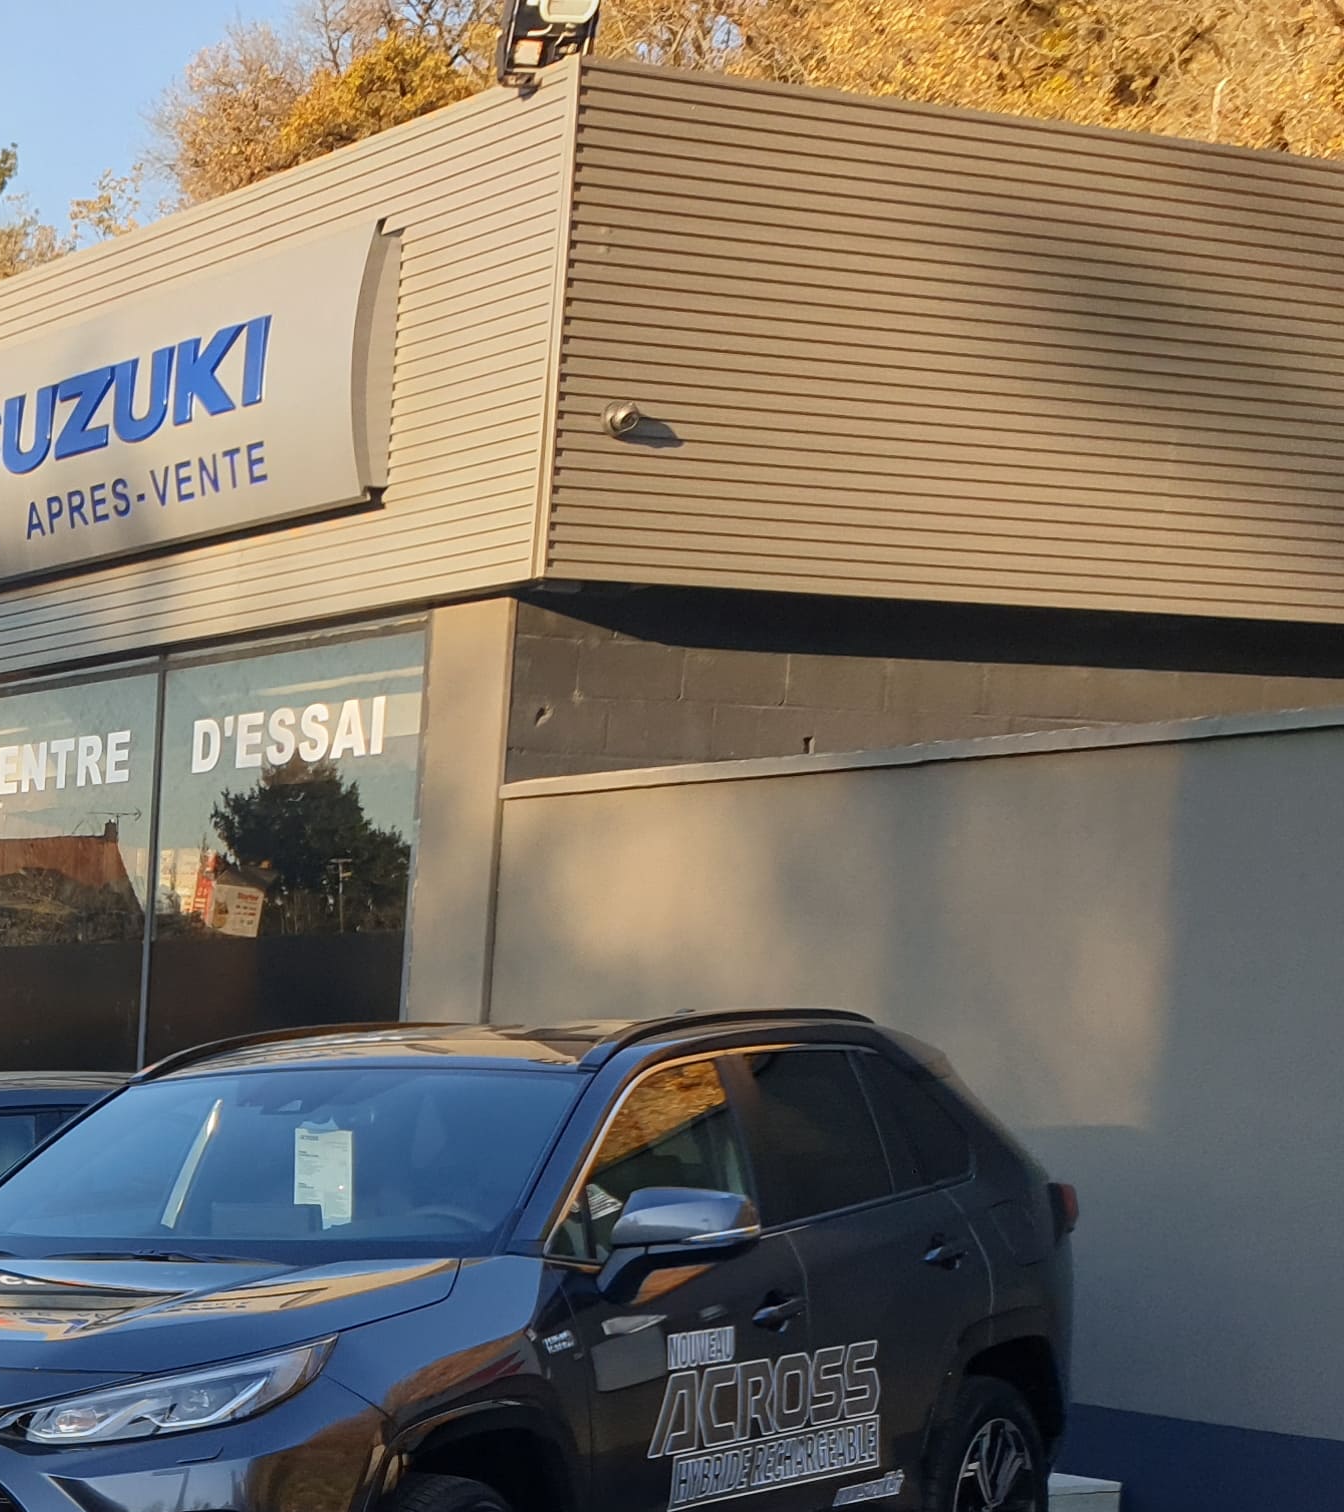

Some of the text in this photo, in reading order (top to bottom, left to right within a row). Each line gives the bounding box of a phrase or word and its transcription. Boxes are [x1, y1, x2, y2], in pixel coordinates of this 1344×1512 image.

[25, 441, 269, 541] APRES-VENTE
[191, 696, 386, 775] D'ESSAI
[667, 1326, 735, 1370] NOUVEAU
[647, 1340, 880, 1459] ACROSS
[673, 1421, 878, 1504] HYBRIDE RECHARGEABLE
